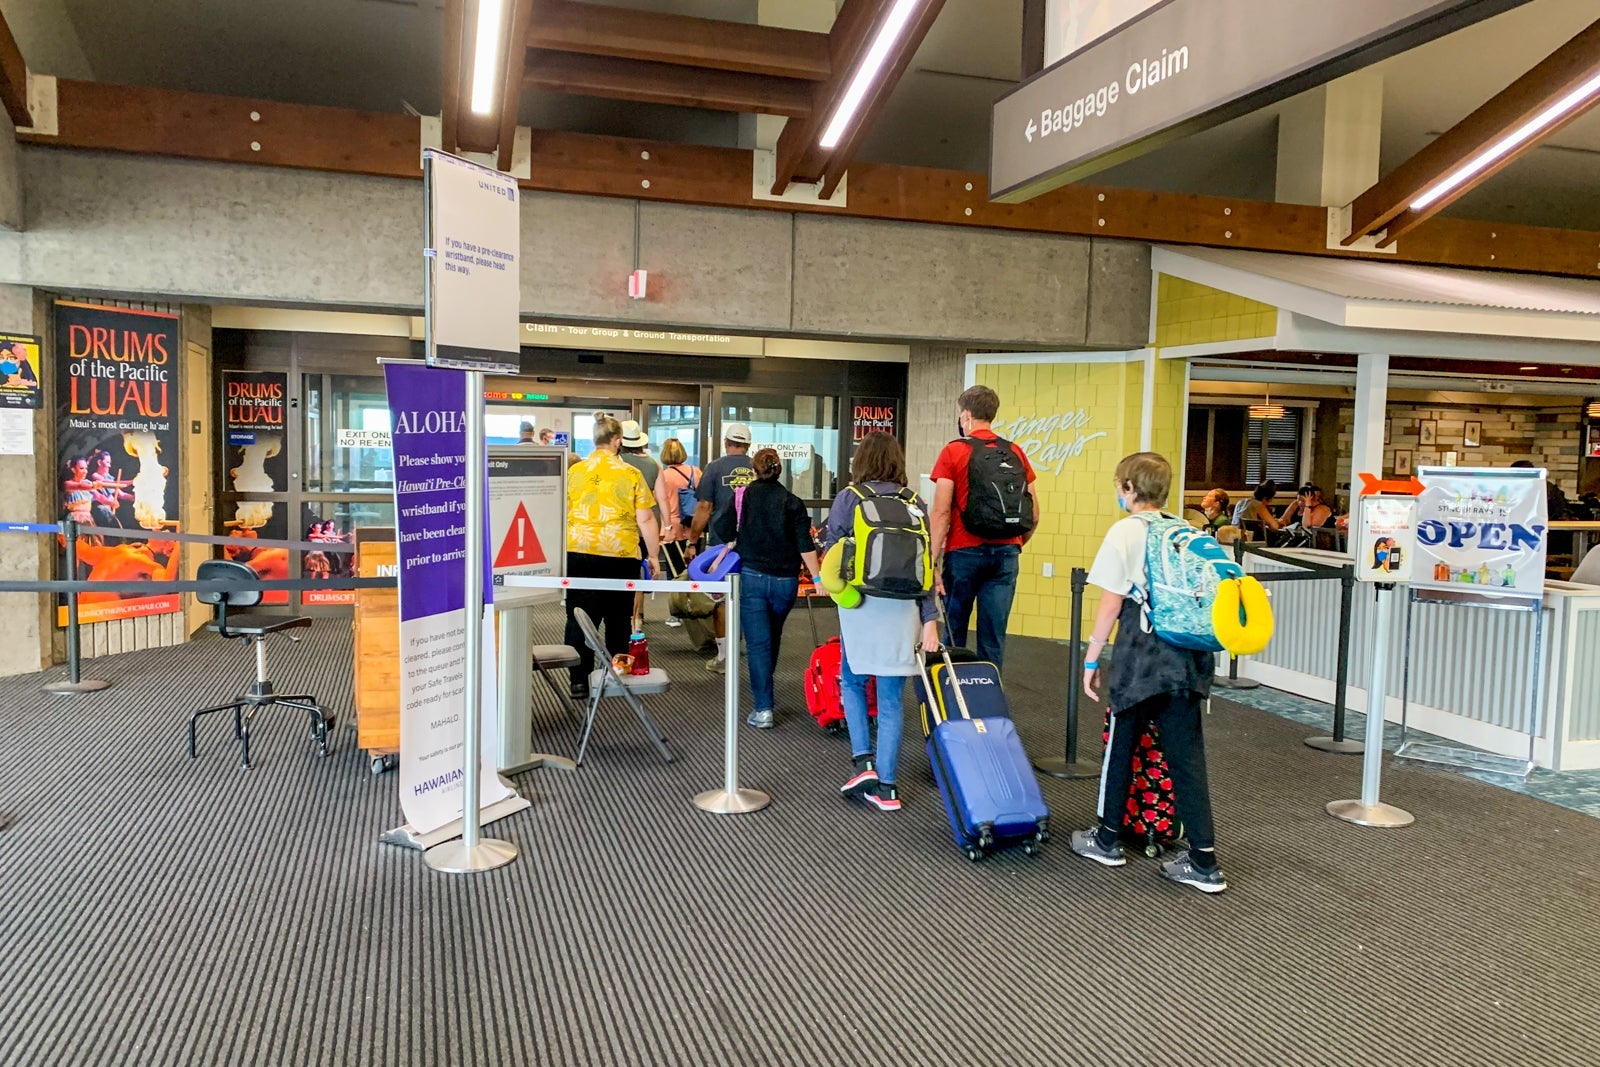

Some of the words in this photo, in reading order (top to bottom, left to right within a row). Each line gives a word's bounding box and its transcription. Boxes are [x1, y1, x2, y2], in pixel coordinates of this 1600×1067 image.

[1041, 81, 1120, 138] Baggage
[1125, 45, 1189, 95] Claim
[478, 180, 506, 196] UNITED
[445, 236, 450, 246] If
[451, 239, 462, 249] you
[463, 242, 476, 252] have
[482, 247, 514, 262] pre-clearance
[445, 250, 475, 264] wristband,
[476, 257, 492, 268] please
[492, 261, 505, 270] head
[445, 262, 456, 272] this
[457, 266, 470, 276] way.
[526, 323, 558, 333] Claim
[568, 326, 588, 335] Tour
[592, 328, 619, 338] Group
[623, 330, 629, 338] &
[634, 330, 665, 340] Ground
[669, 332, 731, 343] Transportation
[69, 324, 168, 365] DRUMS
[69, 358, 88, 377] of
[90, 360, 116, 378] the
[119, 362, 168, 382] Pacific
[228, 382, 282, 399] DRUMS
[228, 397, 238, 406] of
[240, 397, 253, 406] the
[254, 398, 282, 407] Pacific
[854, 406, 894, 420] DRUMS
[69, 418, 96, 428] Maui's
[98, 420, 117, 429] most
[119, 422, 148, 432] exciting
[394, 410, 466, 434] ALOHA
[854, 418, 861, 426] of
[872, 420, 894, 428] Pacific
[398, 454, 430, 467] Please
[430, 453, 453, 465] show
[454, 456, 466, 466] yo
[496, 460, 508, 470] Only
[435, 476, 466, 489] Pre-Cle
[402, 501, 448, 517] wristband
[449, 500, 457, 512] if
[456, 502, 466, 514] yo
[400, 530, 422, 543] have
[422, 528, 445, 540] been
[446, 524, 466, 537] clear
[1417, 520, 1545, 552] OPEN
[406, 554, 430, 570] prior
[432, 552, 441, 563] to
[442, 548, 466, 561] arriva
[376, 564, 399, 578] INF
[310, 593, 356, 602] DRUMSOFT
[416, 638, 428, 648] you
[430, 633, 446, 642] have
[446, 629, 456, 638] not
[432, 646, 452, 658] please
[416, 666, 428, 676] the
[428, 662, 448, 674] queue
[449, 659, 460, 669] and
[412, 682, 427, 694] your
[428, 678, 442, 688] Safe
[443, 672, 464, 684] Travels
[406, 700, 422, 710] code
[424, 694, 442, 705] ready
[442, 690, 451, 699] for
[430, 714, 459, 730] MAHALO
[414, 768, 464, 796] HAWAIIAN
